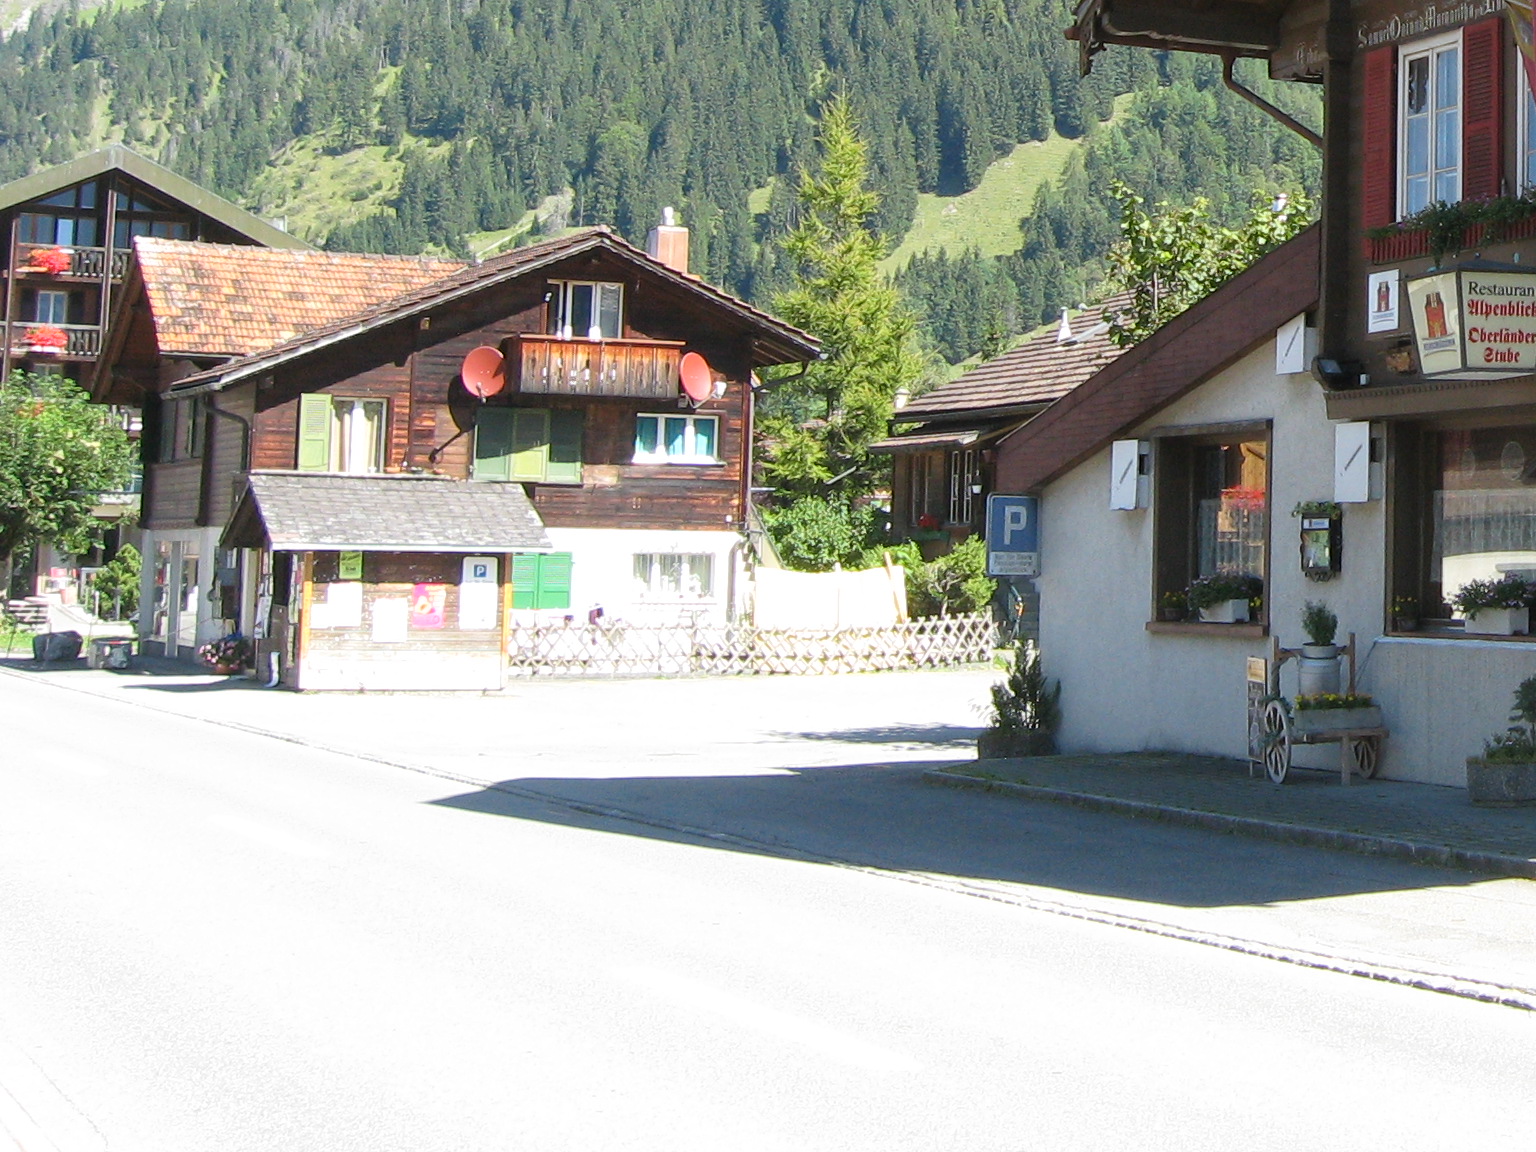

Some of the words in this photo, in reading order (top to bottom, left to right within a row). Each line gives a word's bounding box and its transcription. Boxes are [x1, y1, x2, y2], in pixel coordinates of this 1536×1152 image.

[1467, 326, 1536, 344] Oberländer
[1483, 346, 1521, 364] Stube
[1004, 505, 1027, 545] P
[476, 565, 485, 576] P
